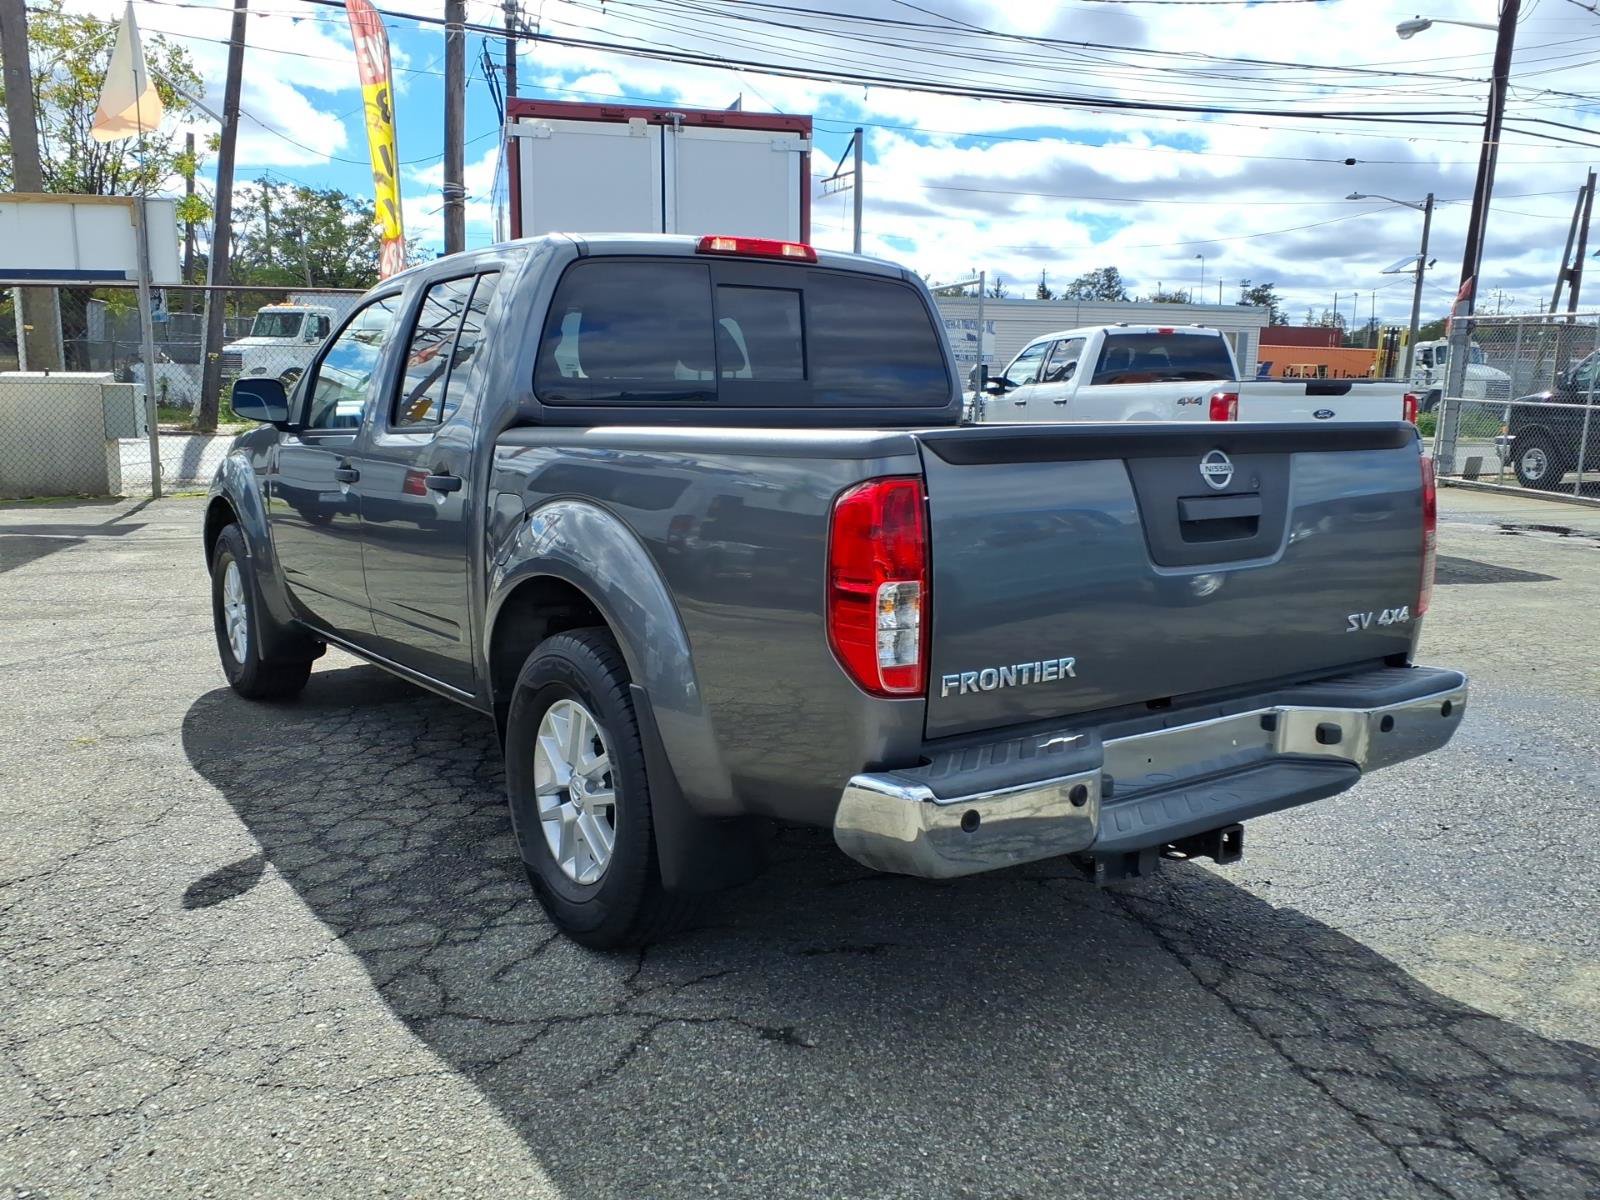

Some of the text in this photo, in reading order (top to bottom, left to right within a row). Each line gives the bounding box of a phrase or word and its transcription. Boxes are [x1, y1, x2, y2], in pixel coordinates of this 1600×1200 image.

[1204, 464, 1233, 474] NISSAN
[1346, 611, 1373, 633] SV
[941, 656, 1077, 698] FRONTIER
